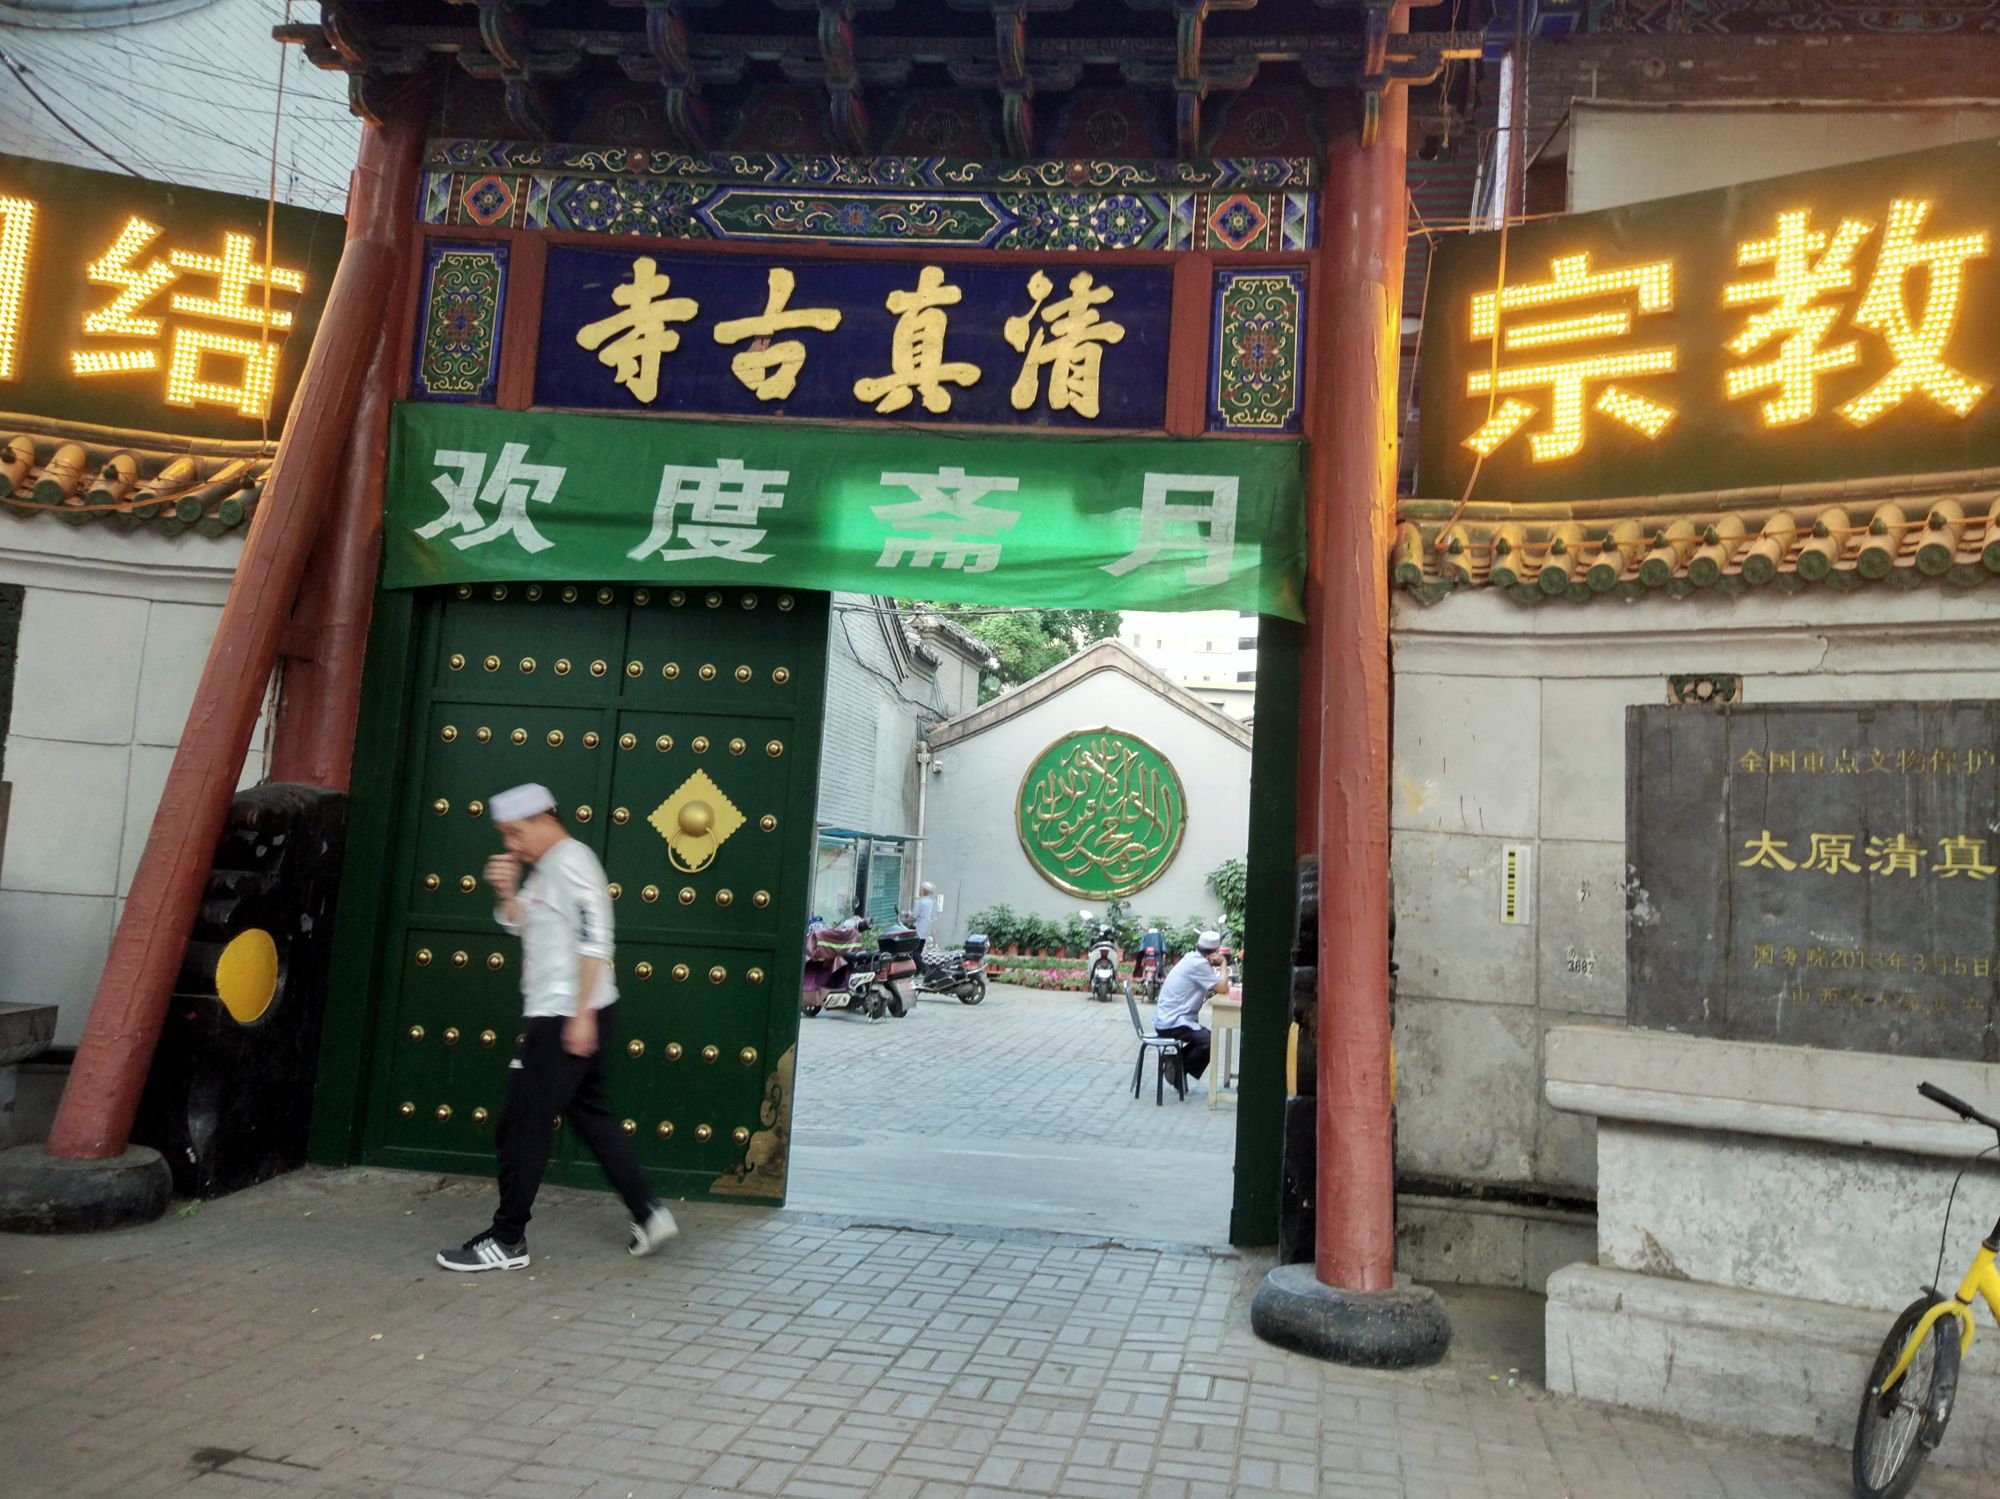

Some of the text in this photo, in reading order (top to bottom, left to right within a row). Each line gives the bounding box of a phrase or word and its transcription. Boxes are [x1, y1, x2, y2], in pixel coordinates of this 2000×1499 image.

[1461, 199, 1991, 462] 宗教
[413, 442, 1262, 585] 欢度斋月
[1738, 829, 1998, 881] 太原清真
